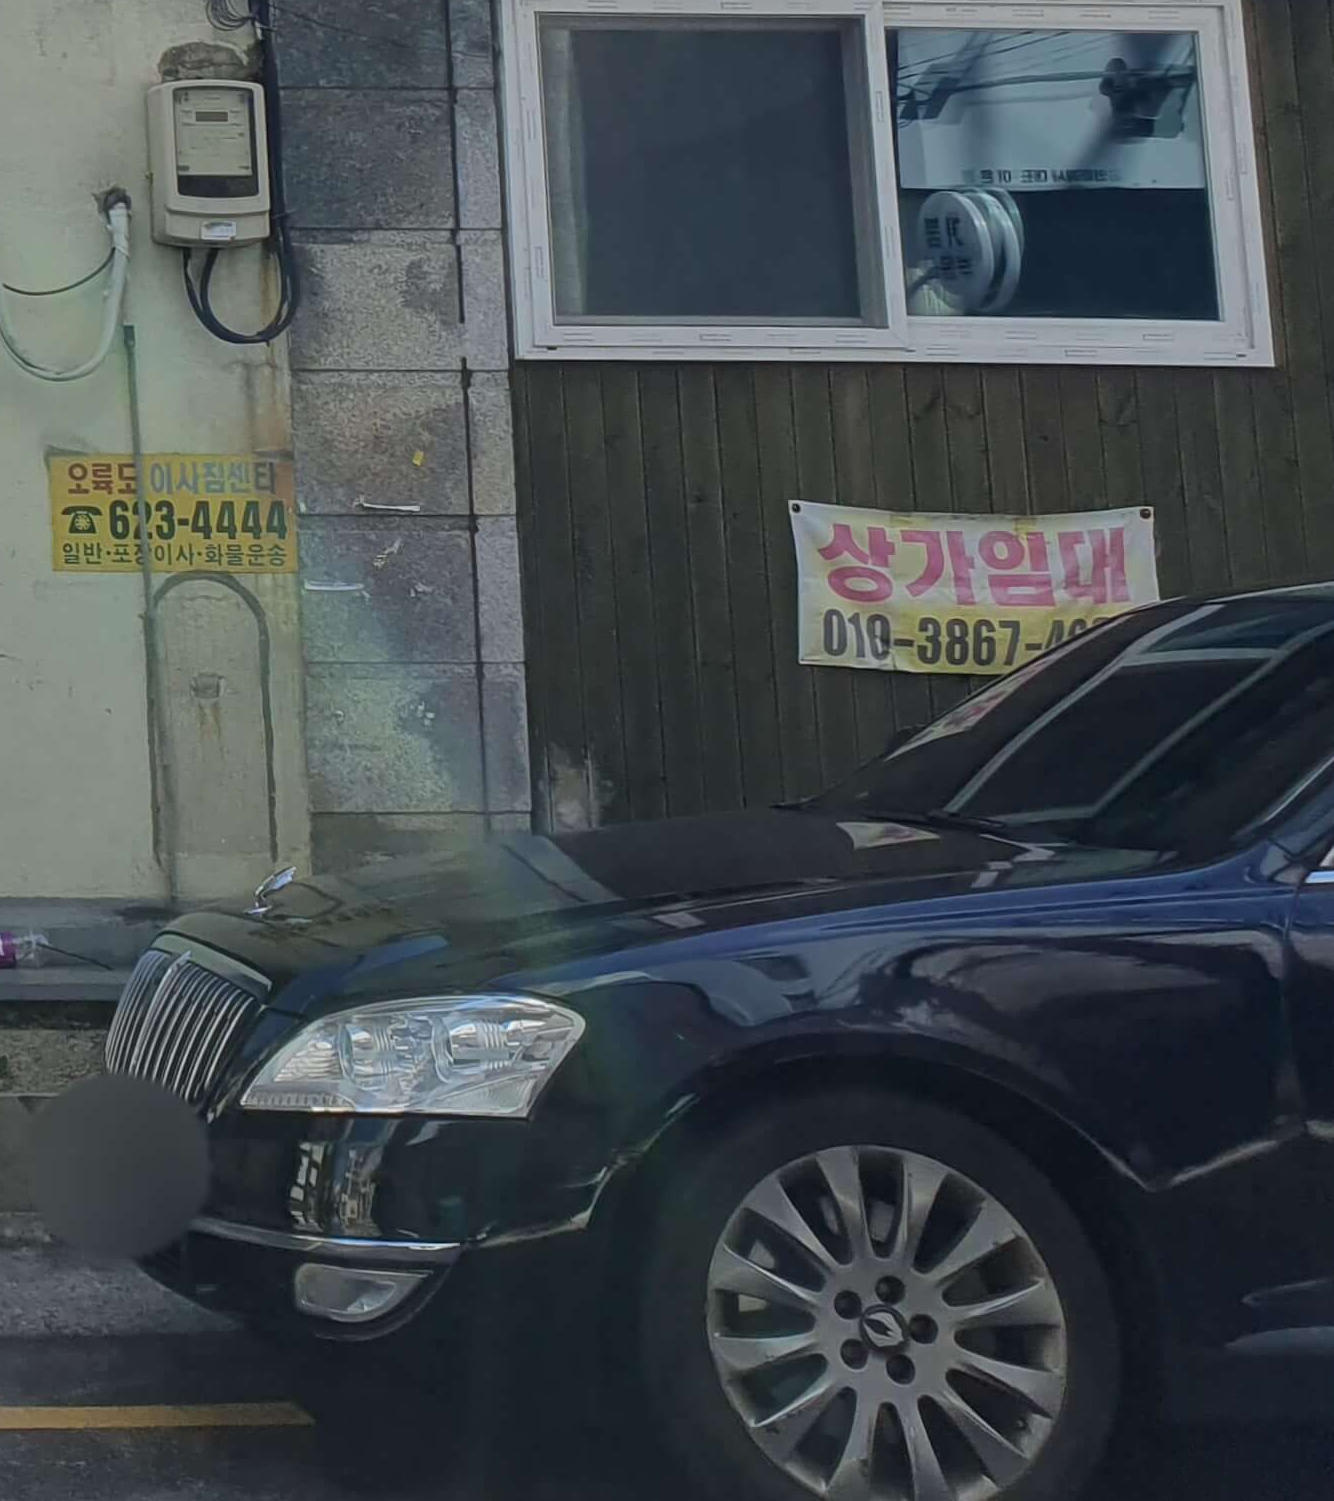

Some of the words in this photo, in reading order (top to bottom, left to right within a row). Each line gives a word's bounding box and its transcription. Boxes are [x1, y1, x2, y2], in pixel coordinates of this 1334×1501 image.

[67, 462, 142, 496] 오륙도
[108, 499, 289, 541] 623-4444
[817, 522, 1132, 608] 상가임대
